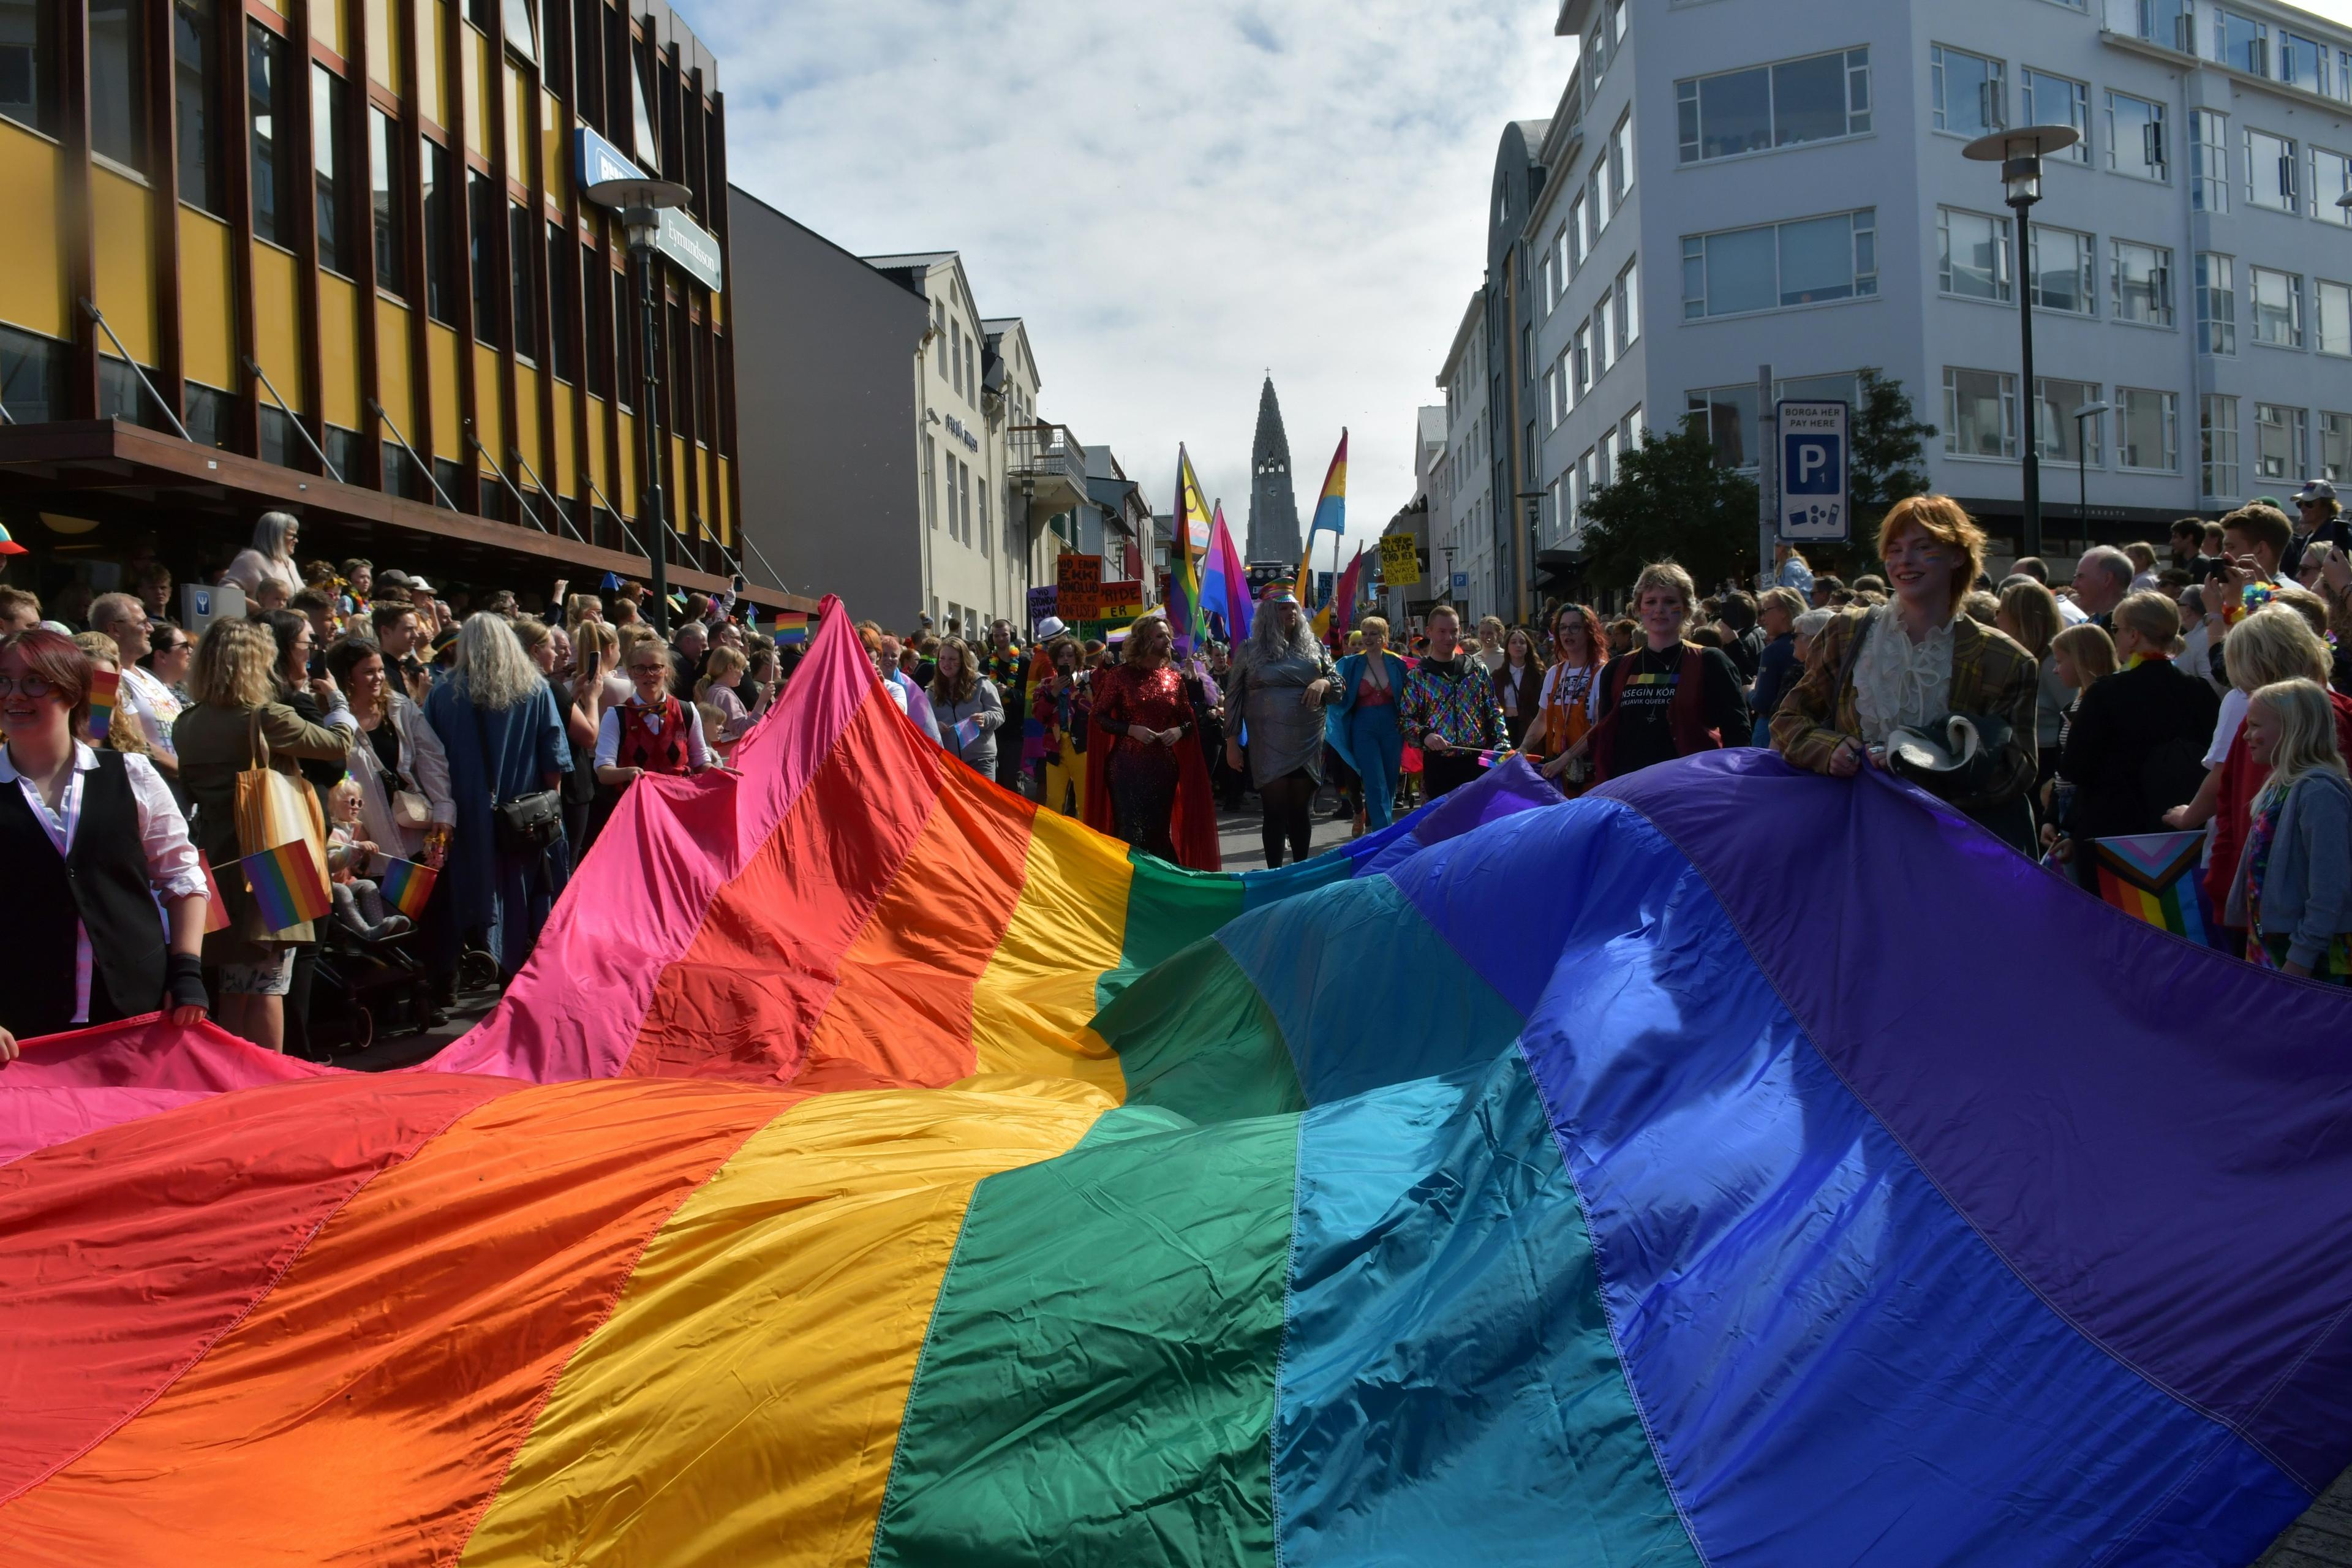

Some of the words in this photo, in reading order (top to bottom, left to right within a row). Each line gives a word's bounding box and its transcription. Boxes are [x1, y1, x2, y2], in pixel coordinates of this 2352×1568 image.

[668, 218, 715, 271] Eymundsson
[1821, 407, 1840, 417] HÉR
[1799, 443, 1826, 484] P
[1819, 472, 1825, 483] 1
[1078, 560, 1098, 570] ERUM
[1059, 569, 1098, 581] EKKI
[1386, 566, 1415, 575] ALWAYS
[1402, 573, 1418, 583] HERE
[1457, 576, 1463, 585] P
[1058, 594, 1069, 603] WE
[1032, 606, 1058, 619] SAMA
[1058, 604, 1098, 618] CONFUSED
[1110, 607, 1127, 617] ER
[1622, 688, 1654, 699] NSEGIN
[1656, 687, 1676, 696] KÓR
[1621, 698, 1644, 707] YKJAVIK
